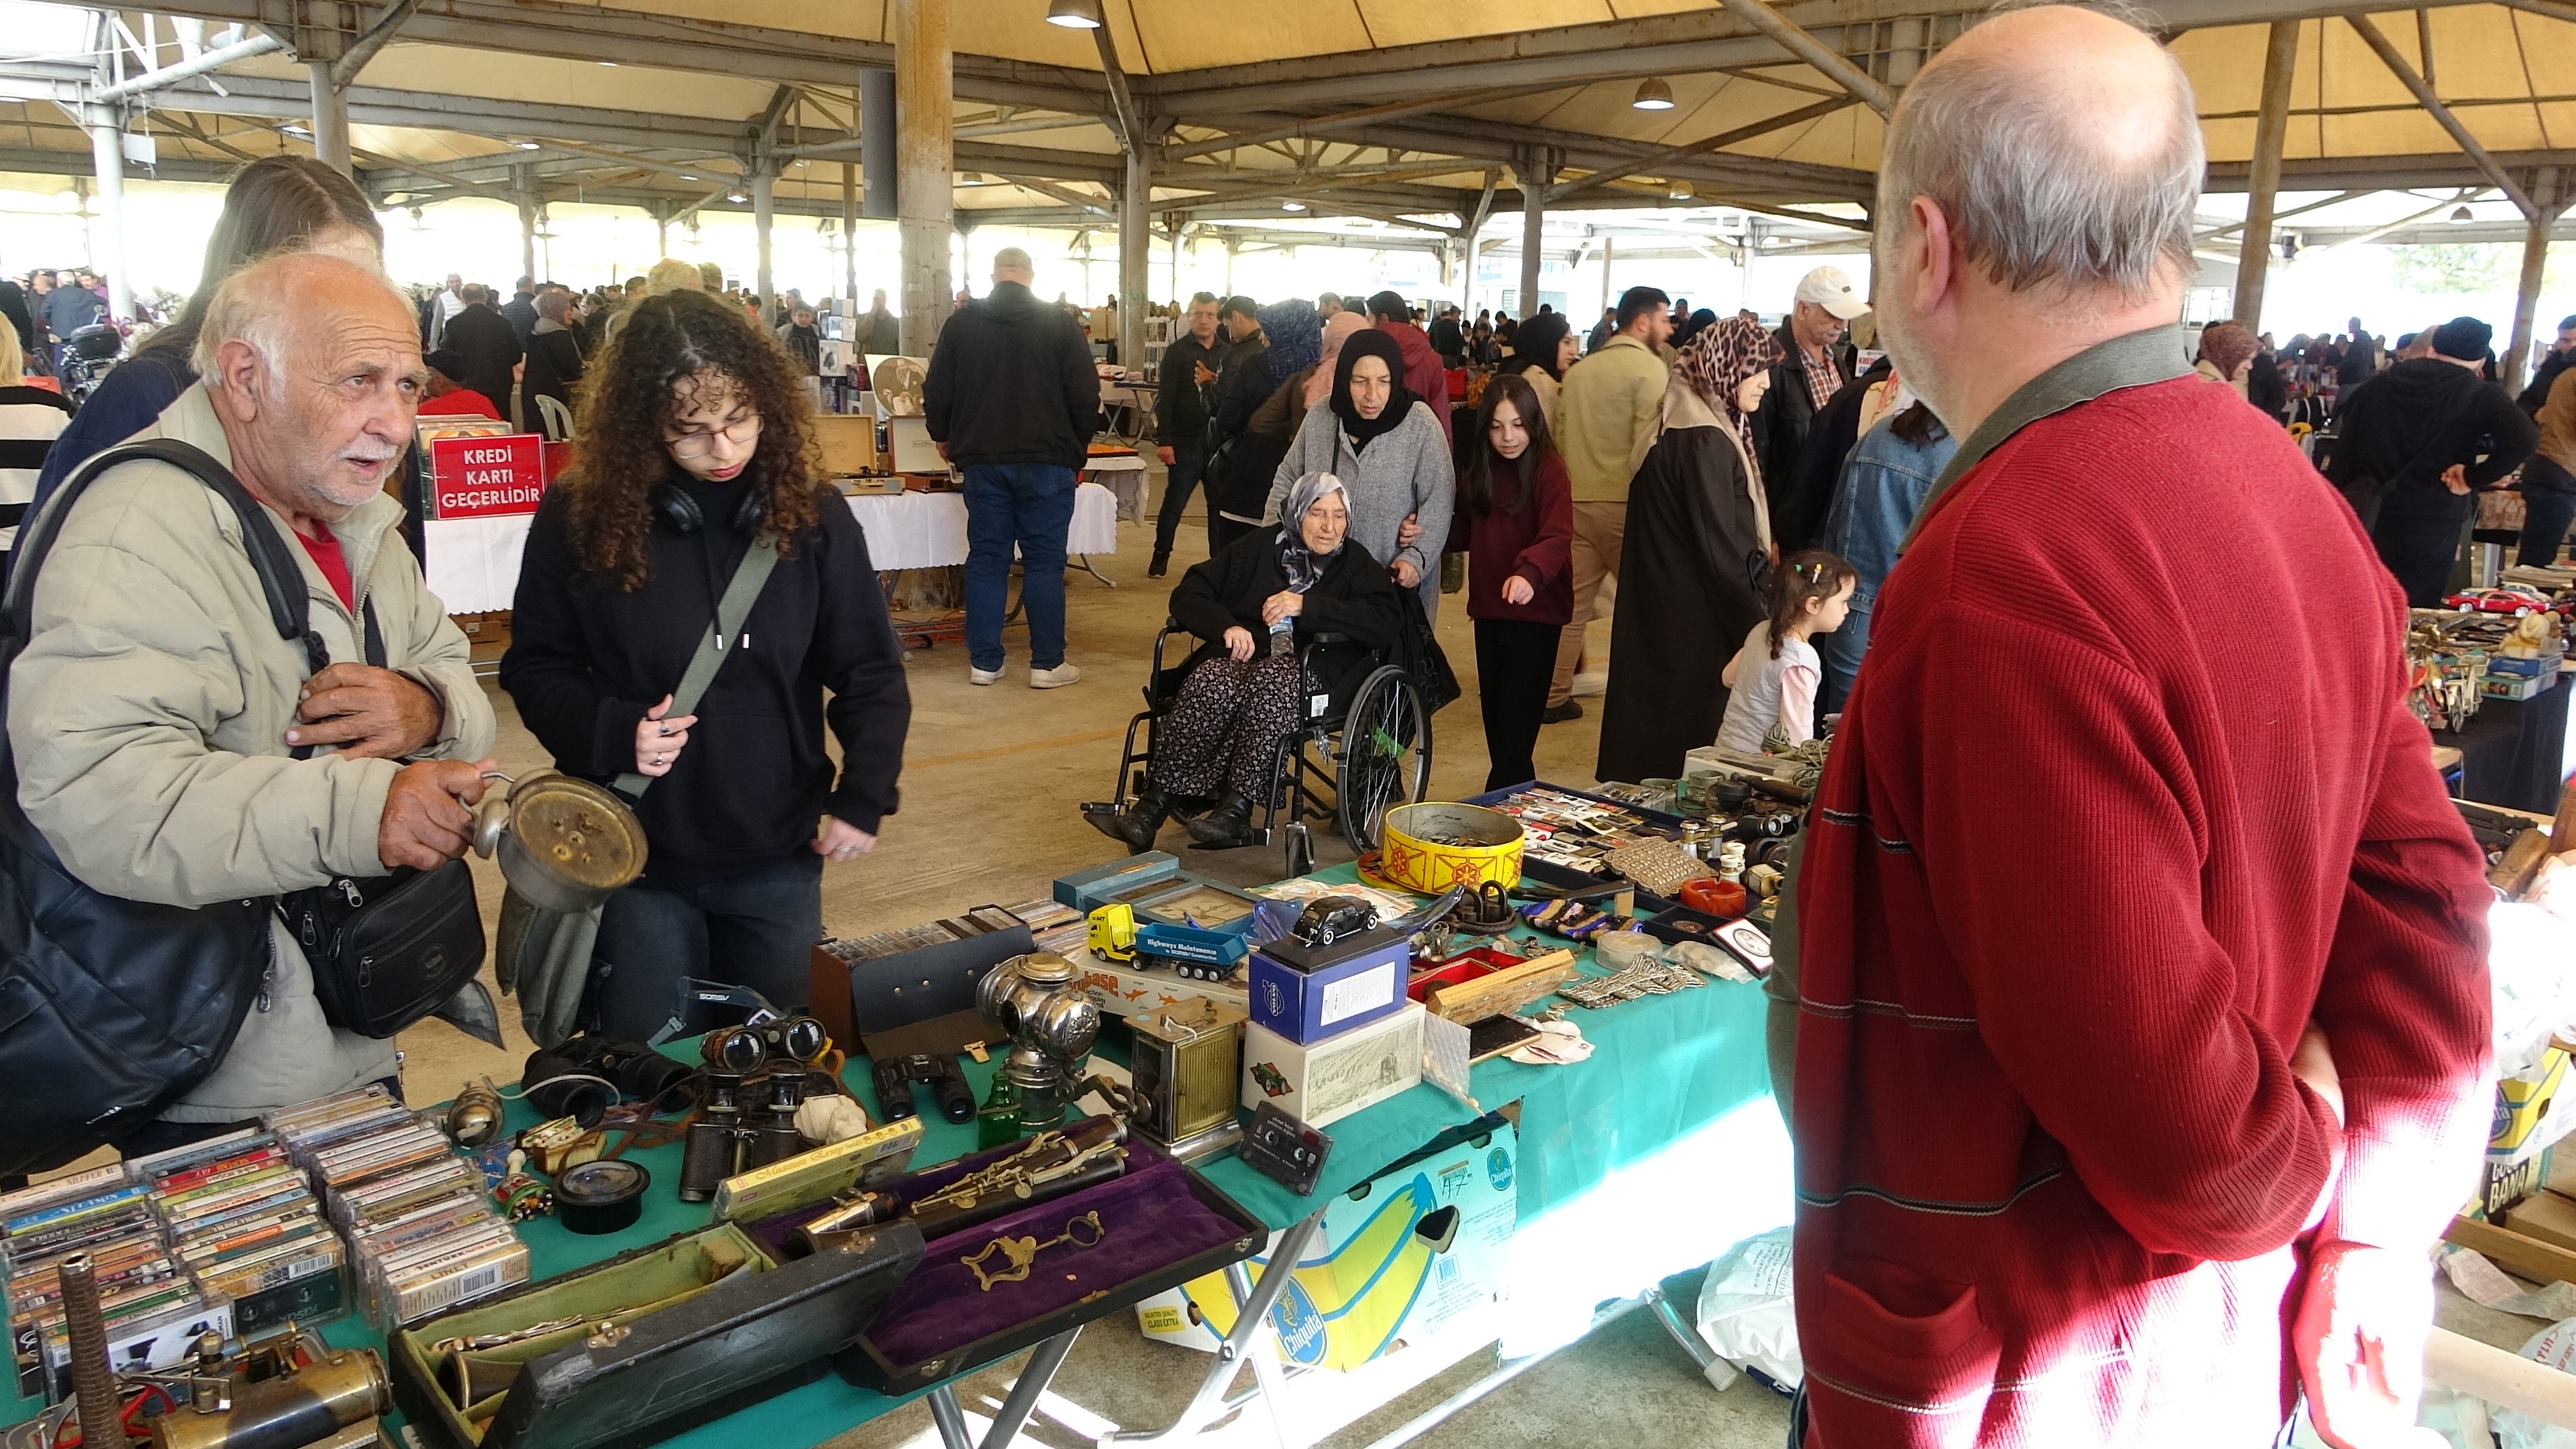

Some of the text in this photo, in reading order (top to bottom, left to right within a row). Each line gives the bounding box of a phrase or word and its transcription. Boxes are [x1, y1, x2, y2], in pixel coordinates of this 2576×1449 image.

[464, 445, 513, 465] KREDİ
[466, 470, 514, 486] KARTI
[441, 486, 541, 510] GEÇERLİDİR
[1147, 938, 1218, 955] Highways Maintenance
[1191, 953, 1218, 961] Construction
[219, 1226, 278, 1248] Trainspotting
[1148, 1318, 1179, 1328] CLASS EXTRA
[1284, 1311, 1324, 1357] Chiquita
